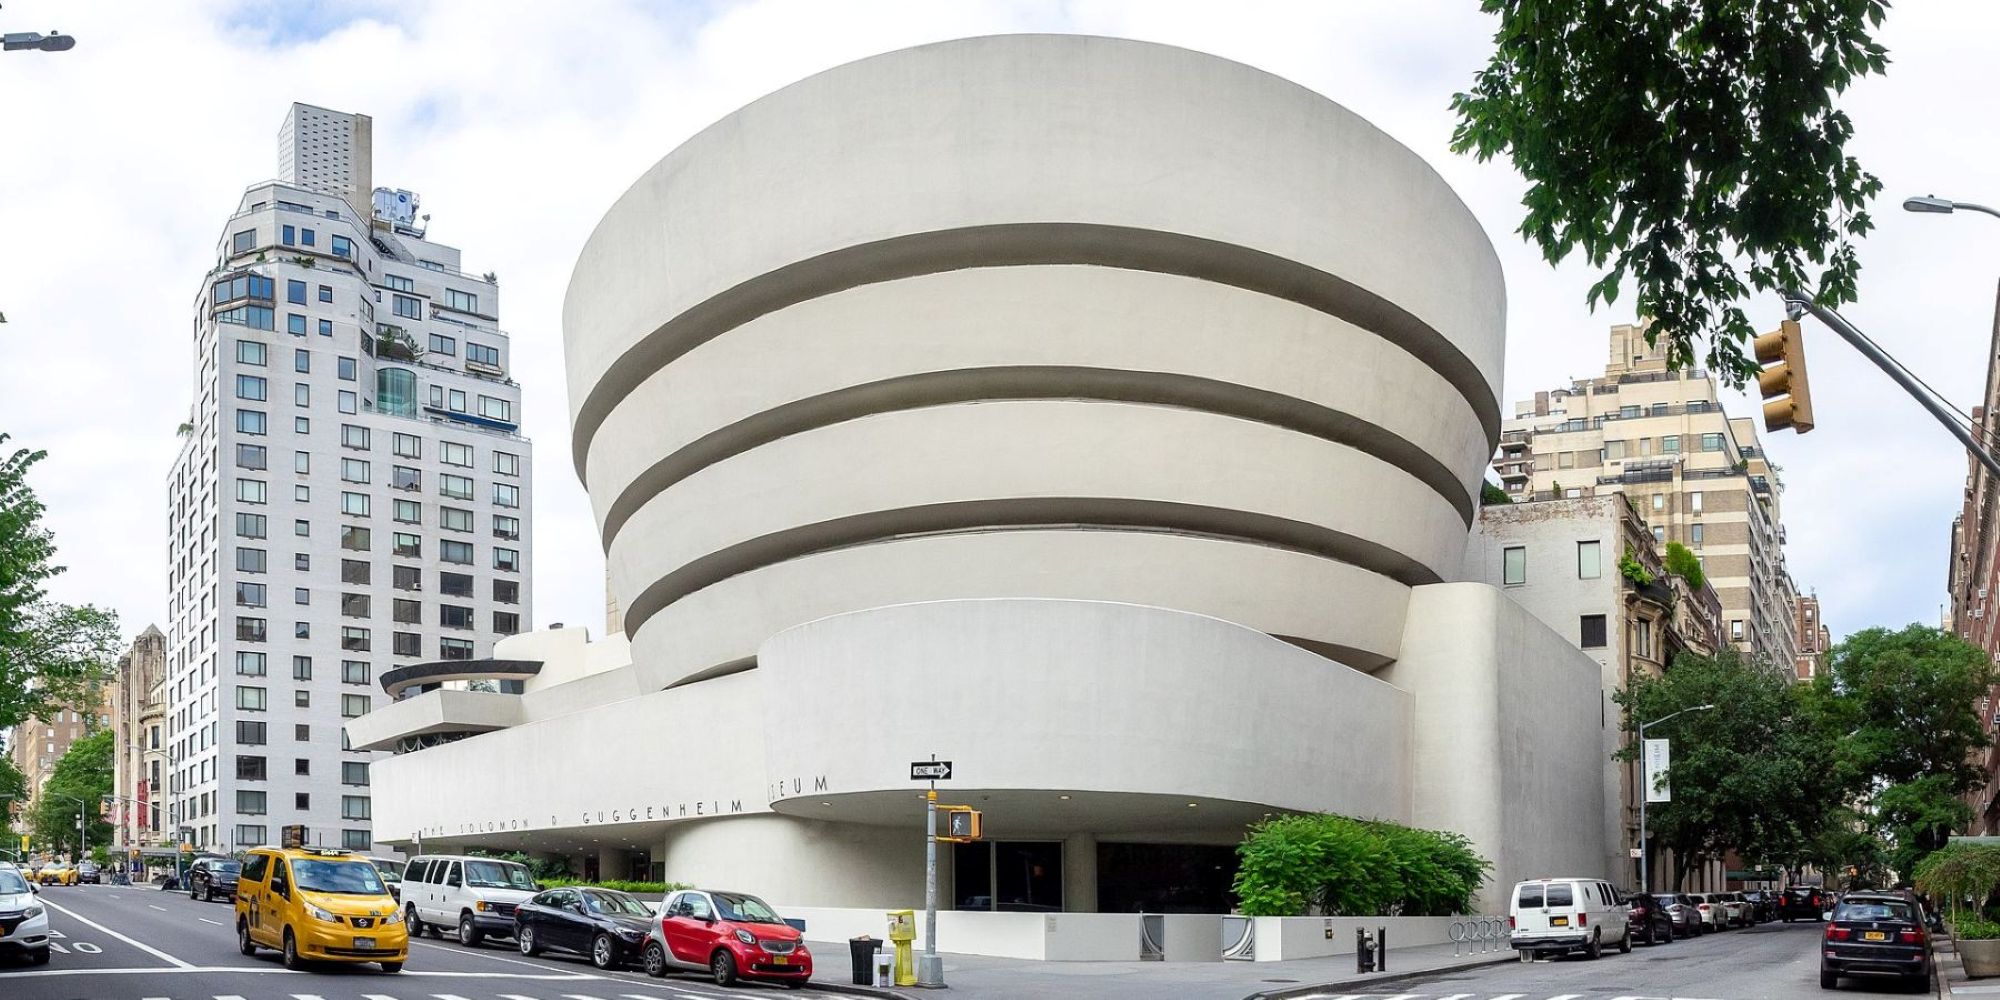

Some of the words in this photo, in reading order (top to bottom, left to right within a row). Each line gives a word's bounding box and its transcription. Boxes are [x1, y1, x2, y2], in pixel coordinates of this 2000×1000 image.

[915, 767, 929, 775] ONE
[933, 766, 946, 775] WAY
[423, 825, 444, 837] THE
[460, 818, 529, 835] SOLOMON
[582, 799, 742, 824] GUGGENHEIM
